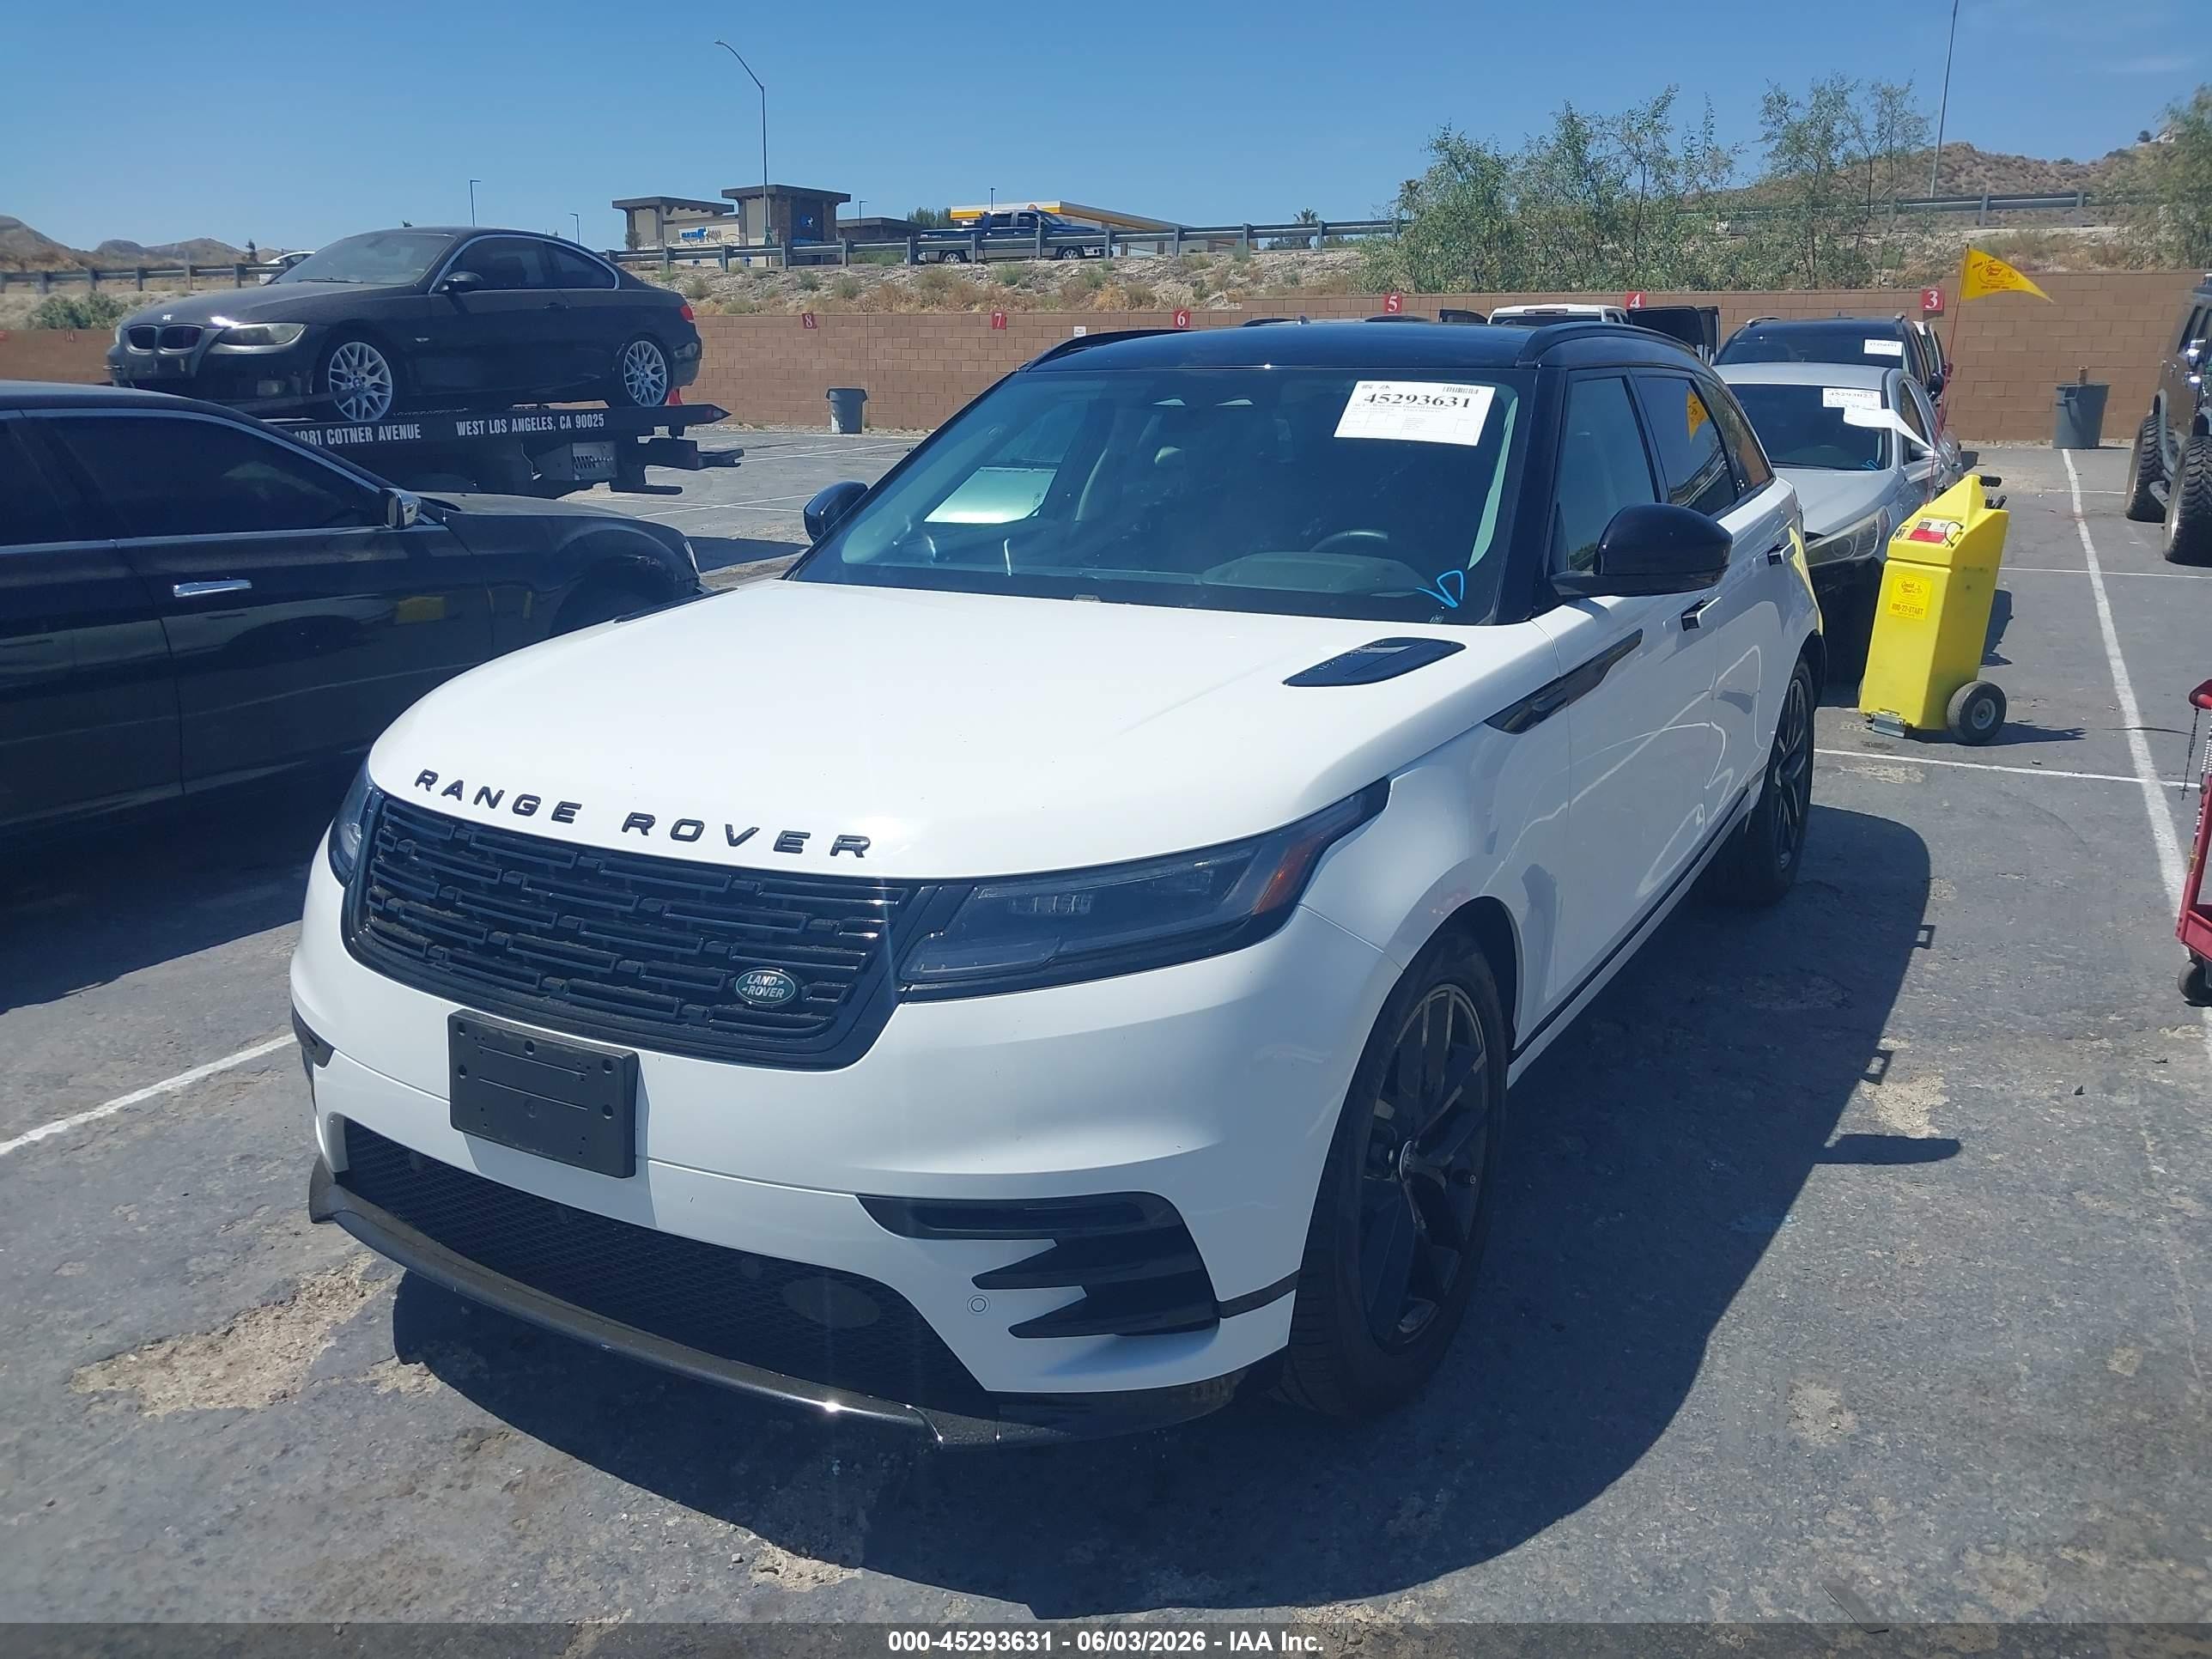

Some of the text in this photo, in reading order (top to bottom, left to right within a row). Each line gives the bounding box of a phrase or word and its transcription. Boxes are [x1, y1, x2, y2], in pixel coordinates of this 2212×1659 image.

[1388, 295, 1398, 312] 5
[1629, 293, 1640, 308] 4
[1925, 290, 1938, 309] 3
[805, 314, 813, 327] 8
[994, 313, 1002, 326] 7
[1176, 313, 1186, 326] 6
[1364, 392, 1471, 409] 45293631
[455, 413, 605, 437] WEST LOS ANGELES, CA 90025
[325, 426, 374, 446] COTNER
[378, 423, 422, 441] AVENUE
[415, 769, 871, 859] RANGE ROVER
[746, 974, 777, 987] LAND
[747, 985, 785, 999] ROVER
